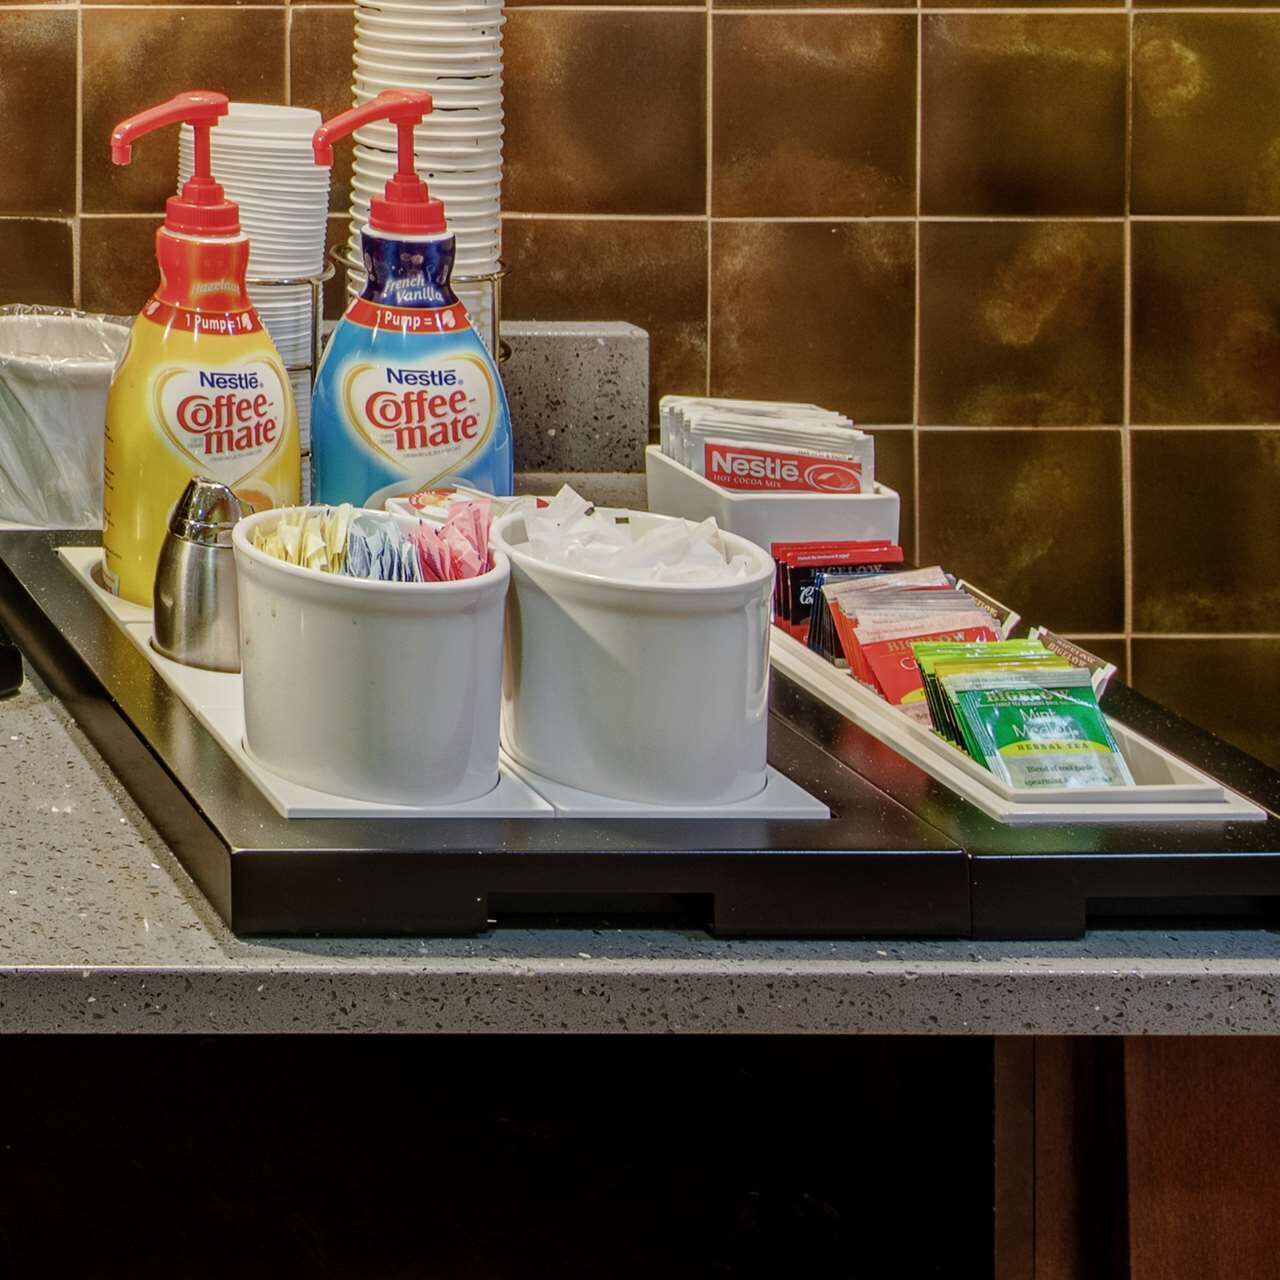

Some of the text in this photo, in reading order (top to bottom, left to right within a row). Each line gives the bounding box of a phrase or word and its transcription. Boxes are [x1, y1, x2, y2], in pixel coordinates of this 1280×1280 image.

[396, 286, 445, 304] Vanilla
[384, 311, 421, 330] Pump
[176, 393, 274, 434] Coffee-
[365, 389, 477, 430] Coffee-
[203, 418, 277, 455] mate
[394, 414, 479, 451] mate
[713, 473, 782, 489] HOT COCOA MIX
